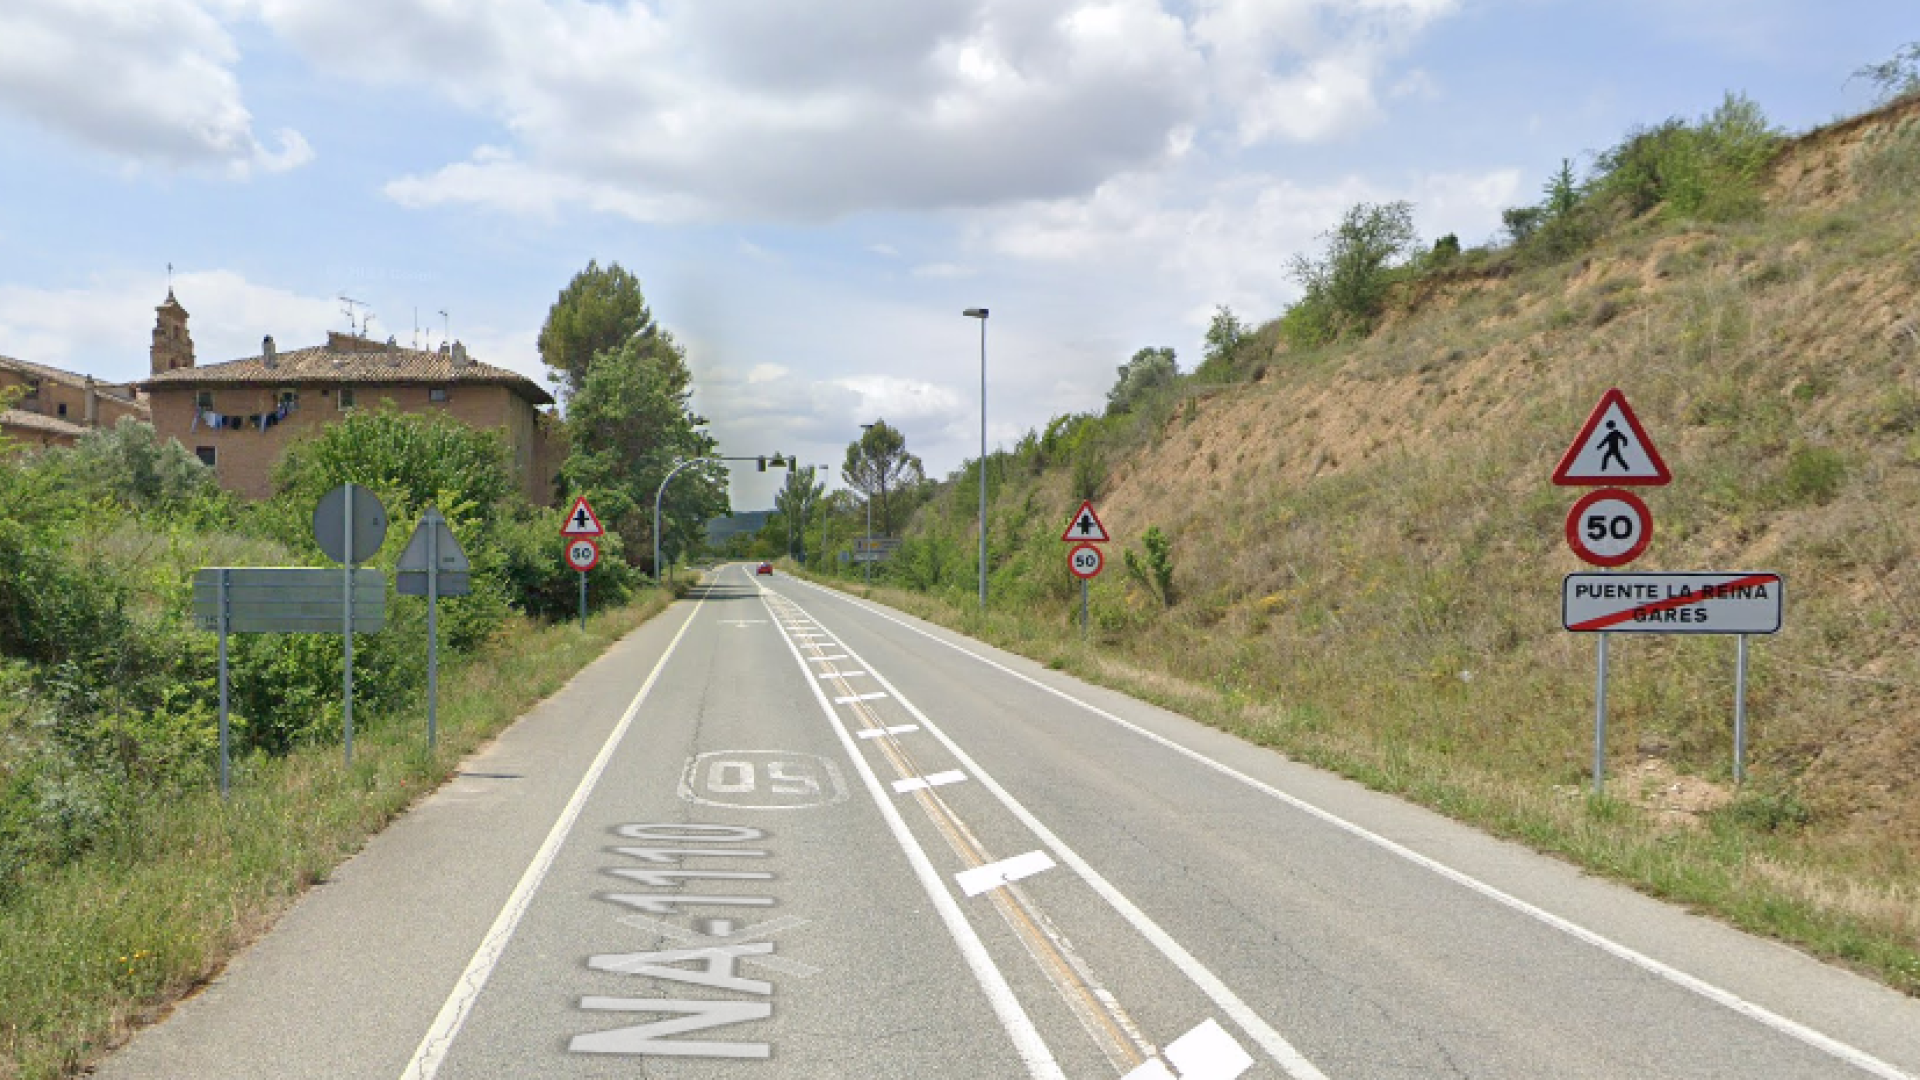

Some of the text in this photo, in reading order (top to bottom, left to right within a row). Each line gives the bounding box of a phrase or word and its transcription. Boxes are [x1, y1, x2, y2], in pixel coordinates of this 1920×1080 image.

[1587, 515, 1633, 540] 50
[572, 547, 592, 560] 50
[1076, 554, 1096, 567] 50
[1575, 584, 1769, 599] PUENTE LA REINA
[1633, 607, 1709, 623] GARES
